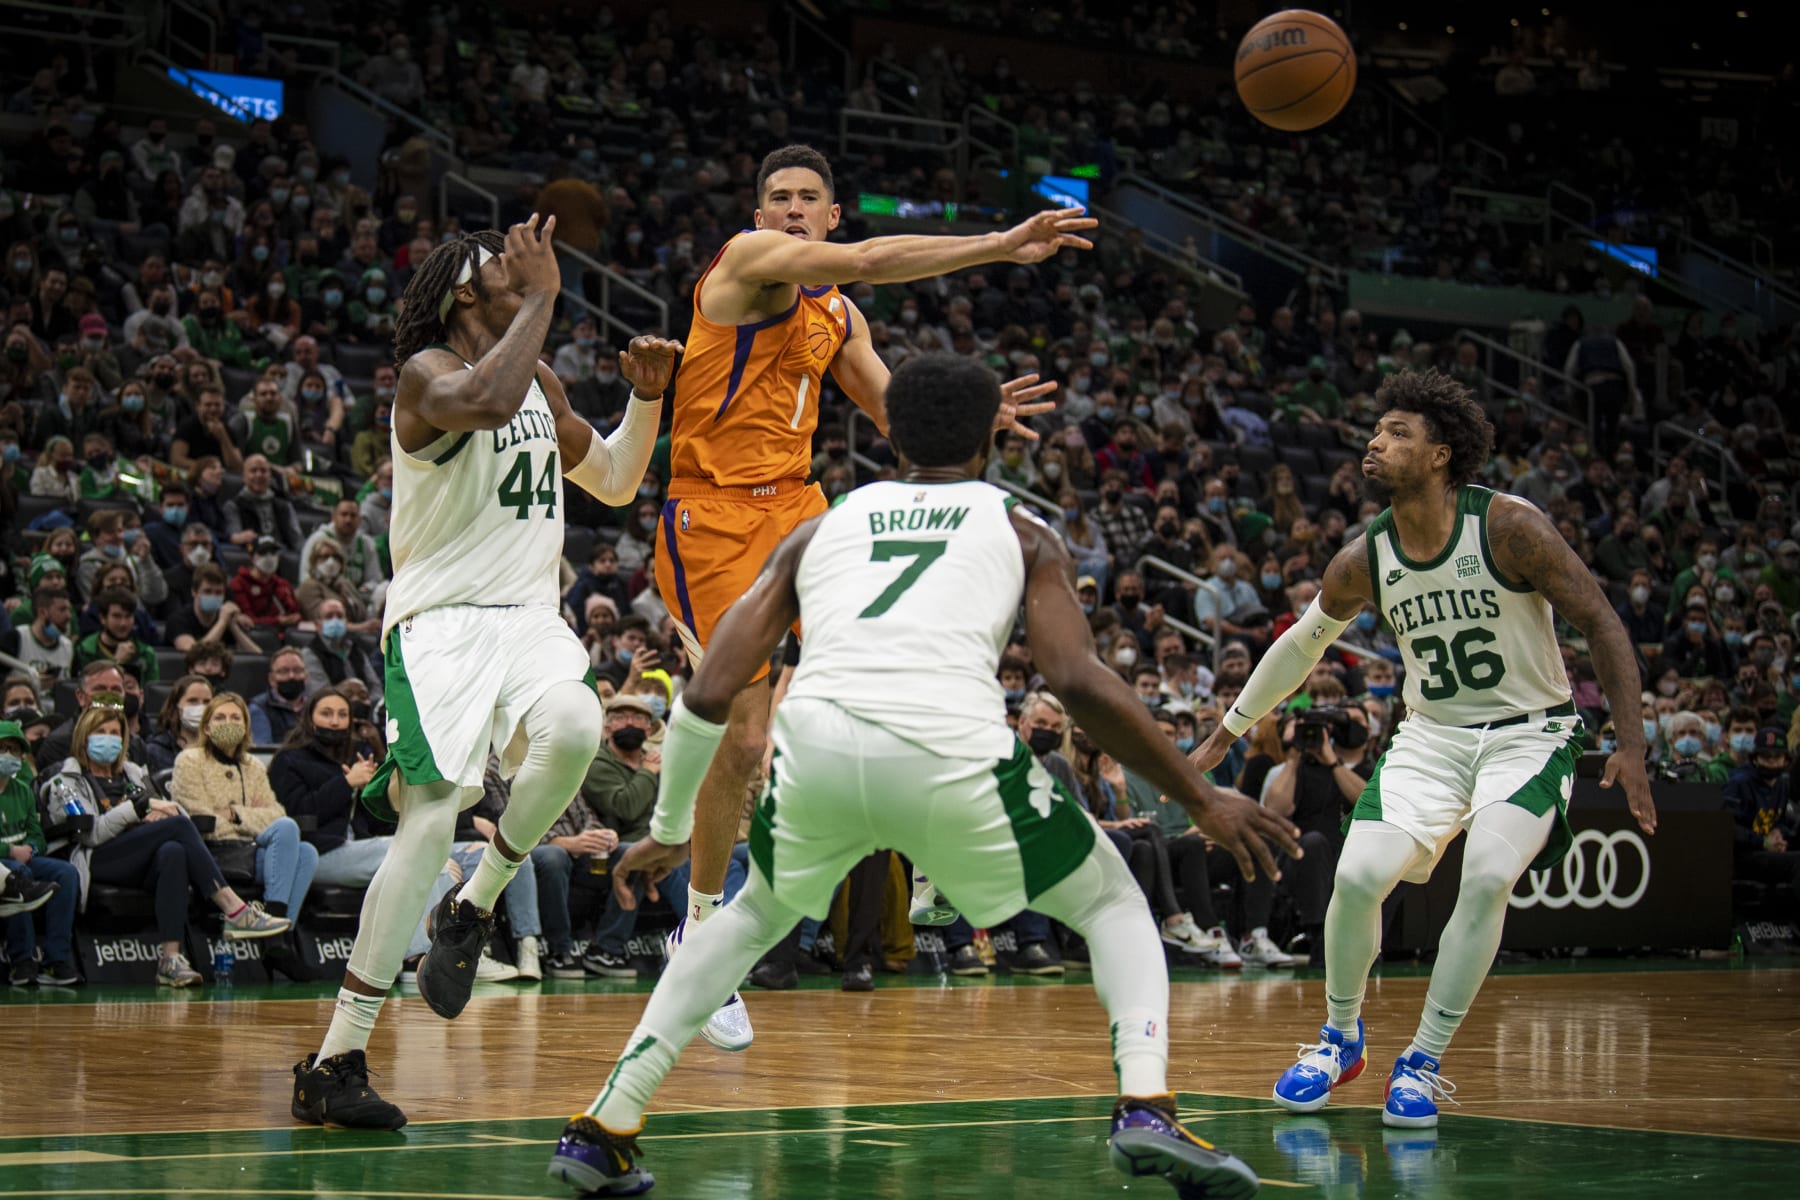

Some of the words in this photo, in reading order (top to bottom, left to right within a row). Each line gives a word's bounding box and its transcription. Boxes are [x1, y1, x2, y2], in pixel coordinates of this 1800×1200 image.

[493, 409, 557, 454] CELTIC
[497, 451, 557, 520] 44
[752, 485, 777, 497] PHX
[868, 506, 970, 535] BROWN
[859, 540, 948, 619] 7
[1455, 554, 1480, 569] VISTA
[1457, 565, 1481, 578] PRINT
[1389, 589, 1500, 636] CELTICS
[1410, 626, 1506, 701] 36
